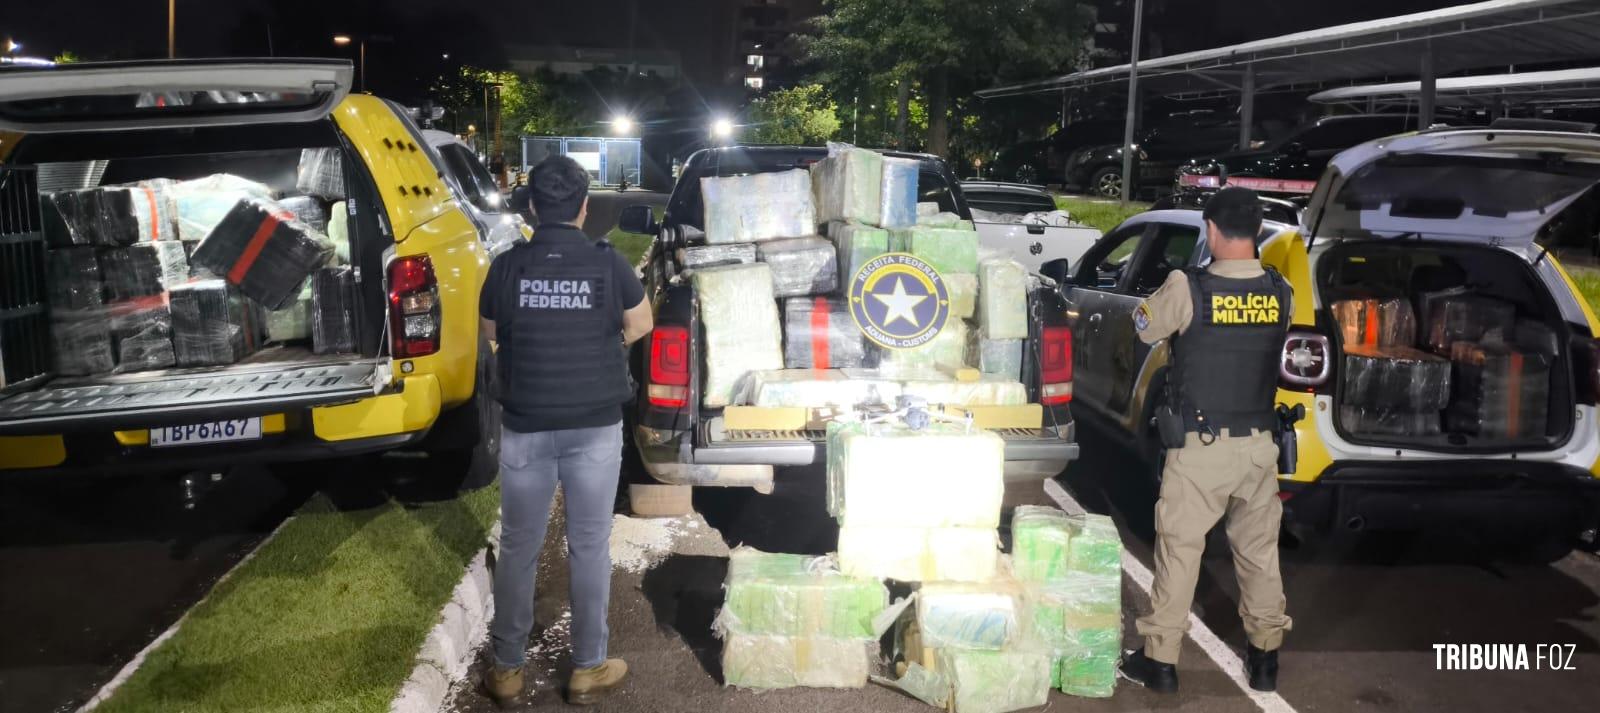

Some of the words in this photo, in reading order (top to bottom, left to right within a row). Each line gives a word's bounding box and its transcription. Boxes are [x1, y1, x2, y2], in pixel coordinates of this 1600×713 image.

[859, 256, 895, 282] RECEITA
[899, 256, 939, 284] FEDERAL
[520, 295, 592, 309] FEDERAL
[1212, 292, 1279, 309] POLÍCIA
[1212, 309, 1279, 323] MILITAR
[865, 325, 897, 346] ADUANA
[902, 327, 938, 347] CUSTOMS
